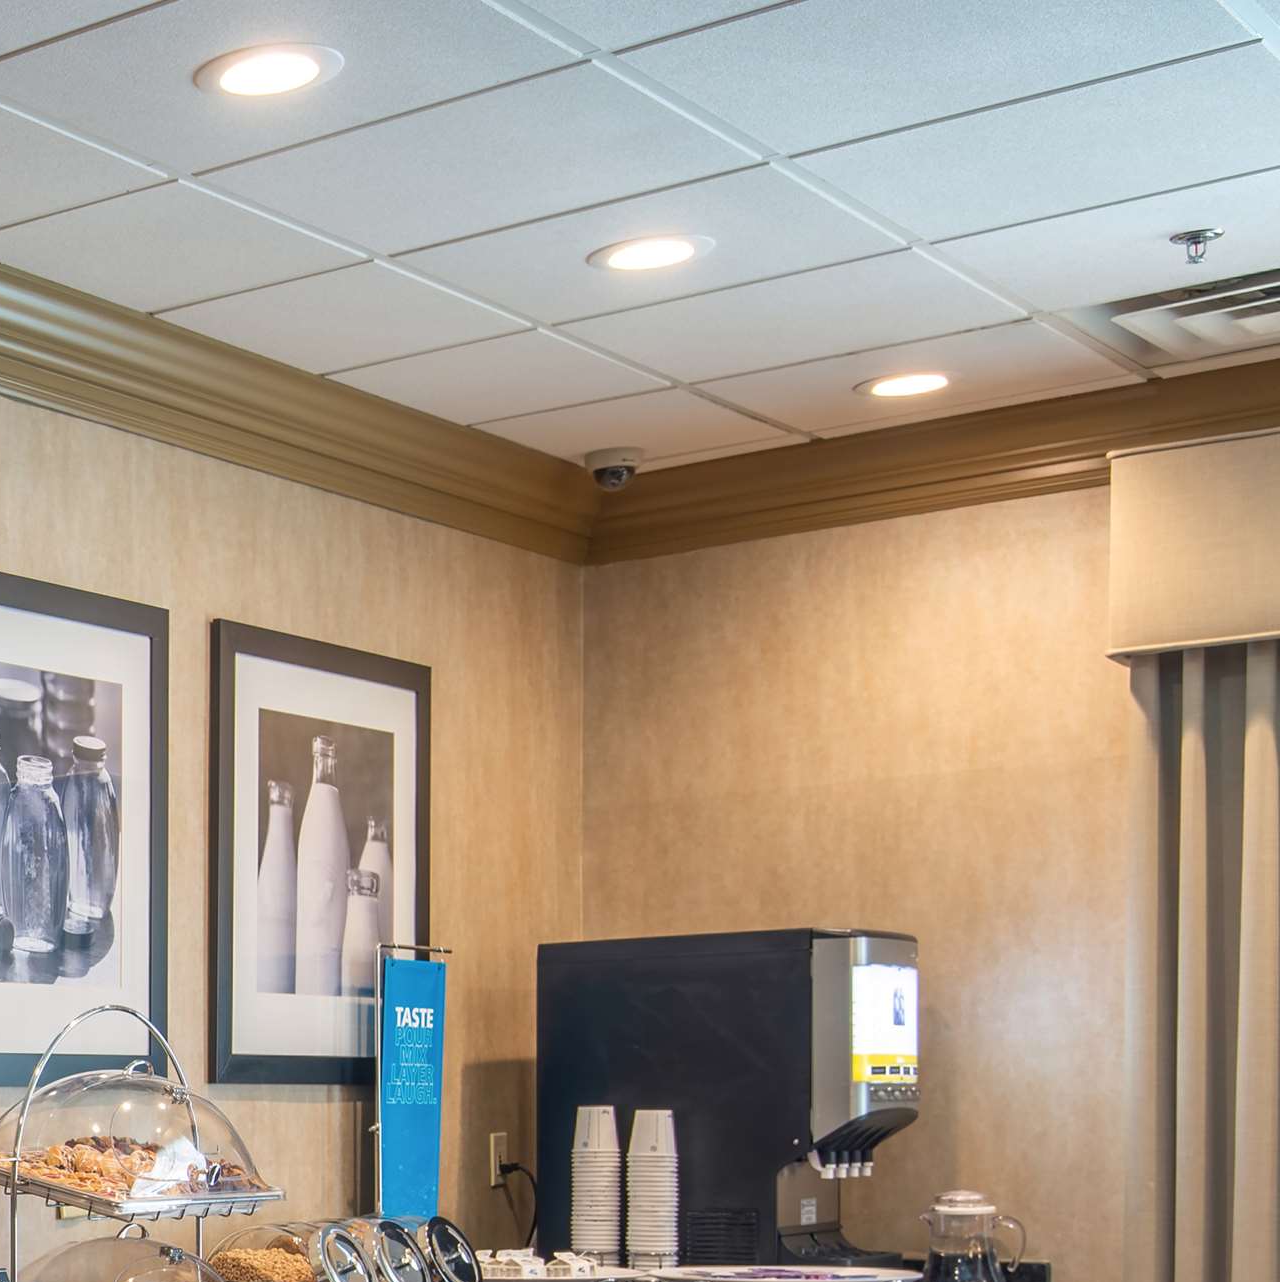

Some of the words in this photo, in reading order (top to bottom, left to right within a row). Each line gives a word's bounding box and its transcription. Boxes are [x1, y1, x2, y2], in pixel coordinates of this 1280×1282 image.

[395, 1006, 434, 1029] TASTE
[394, 1027, 433, 1048] POUR
[400, 1044, 428, 1066] MIX
[391, 1063, 434, 1086] LAYER
[386, 1082, 438, 1105] LAUGH.
